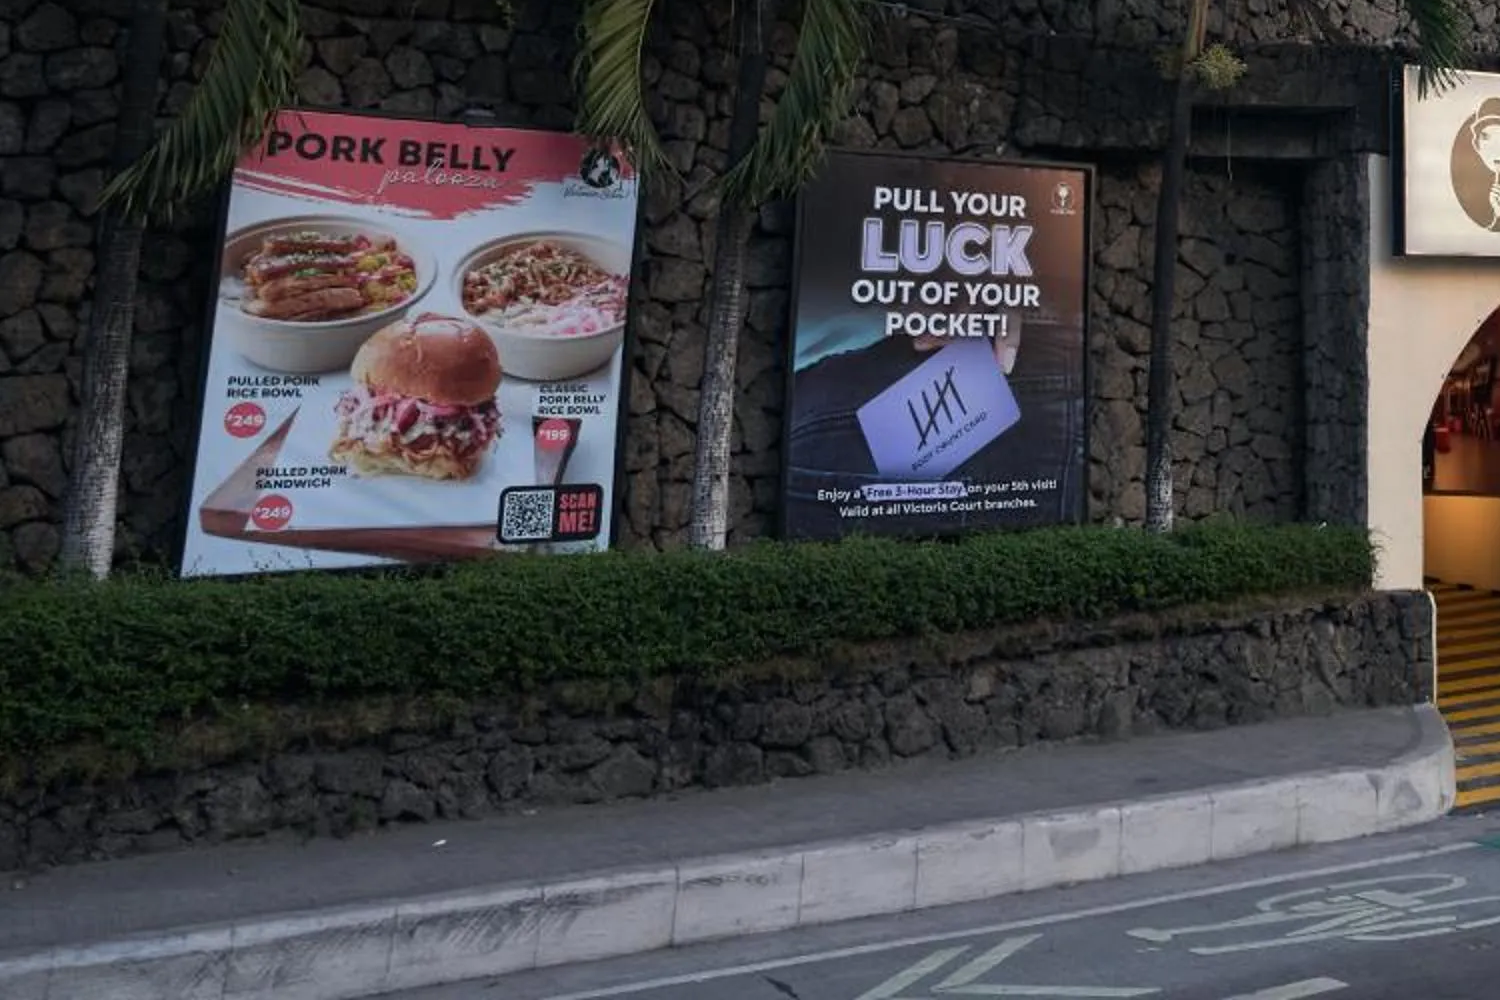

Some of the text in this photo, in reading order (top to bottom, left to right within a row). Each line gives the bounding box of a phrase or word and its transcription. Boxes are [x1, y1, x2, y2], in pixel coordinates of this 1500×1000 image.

[266, 130, 516, 173] PORK BELLY
[874, 186, 1027, 218] PULL YOUR
[861, 218, 1034, 277] LUCK
[851, 279, 1041, 308] OUT OF YOUR
[885, 312, 1009, 337] POCKET!
[227, 375, 320, 386] PULLED PORK
[227, 387, 303, 398] RICE BOWL
[539, 393, 607, 405] PORK BELLY
[538, 405, 601, 415] RICE BOWL
[256, 466, 347, 477] PULLED PORK
[255, 478, 331, 489] SANDWICH
[817, 489, 850, 502] Enjoy
[853, 490, 861, 499] a
[867, 487, 893, 498] Free
[938, 485, 963, 498] Stay
[967, 484, 982, 494] on
[984, 483, 1009, 495] your
[1011, 481, 1029, 492] 5th
[559, 491, 597, 509] SCAN
[840, 505, 869, 517] Valid
[871, 505, 883, 516] at
[885, 503, 900, 515] all
[902, 502, 949, 514] Victoria
[949, 500, 982, 512] Court
[558, 509, 596, 533] ME!
